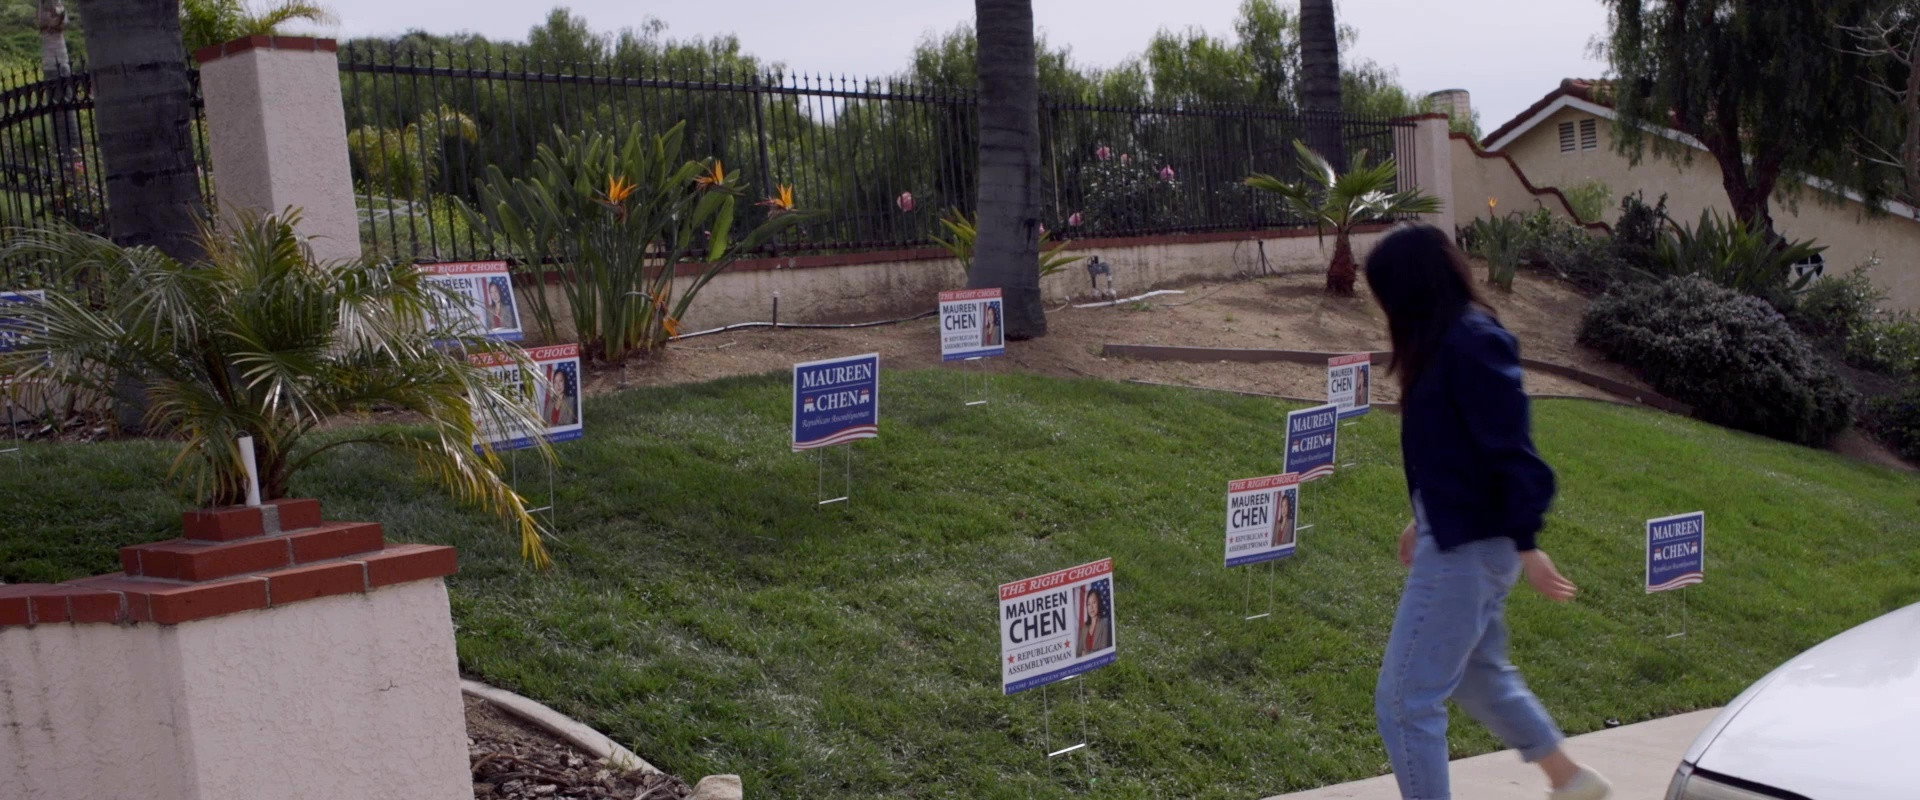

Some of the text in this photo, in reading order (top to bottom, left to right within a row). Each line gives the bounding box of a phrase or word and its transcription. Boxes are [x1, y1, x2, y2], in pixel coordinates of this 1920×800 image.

[438, 264, 469, 273] RIGHT
[470, 262, 506, 271] CHOICE
[943, 303, 977, 314] MAUREEN
[945, 313, 976, 331] CHEN
[536, 346, 577, 359] CHOICE
[802, 363, 872, 388] MAUREEN
[1332, 377, 1352, 393] CHEN
[816, 390, 858, 411] CHEN
[1292, 411, 1334, 433] MAUREEN
[1300, 434, 1325, 452] CHEN
[1230, 474, 1297, 490] THE RIGHT CHOICE
[1231, 493, 1270, 509] MAUREEN
[1232, 506, 1268, 529] CHEN
[1653, 520, 1700, 540] MAUREEN
[1662, 542, 1691, 560] CHEN
[1002, 561, 1110, 597] THE RIGHT CHOICE
[1006, 591, 1068, 619] MAUREEN
[1009, 607, 1066, 644] CHEN
[1017, 641, 1062, 662] REPUBLICAN
[1008, 650, 1072, 676] ASSEMBLYWOMAN
